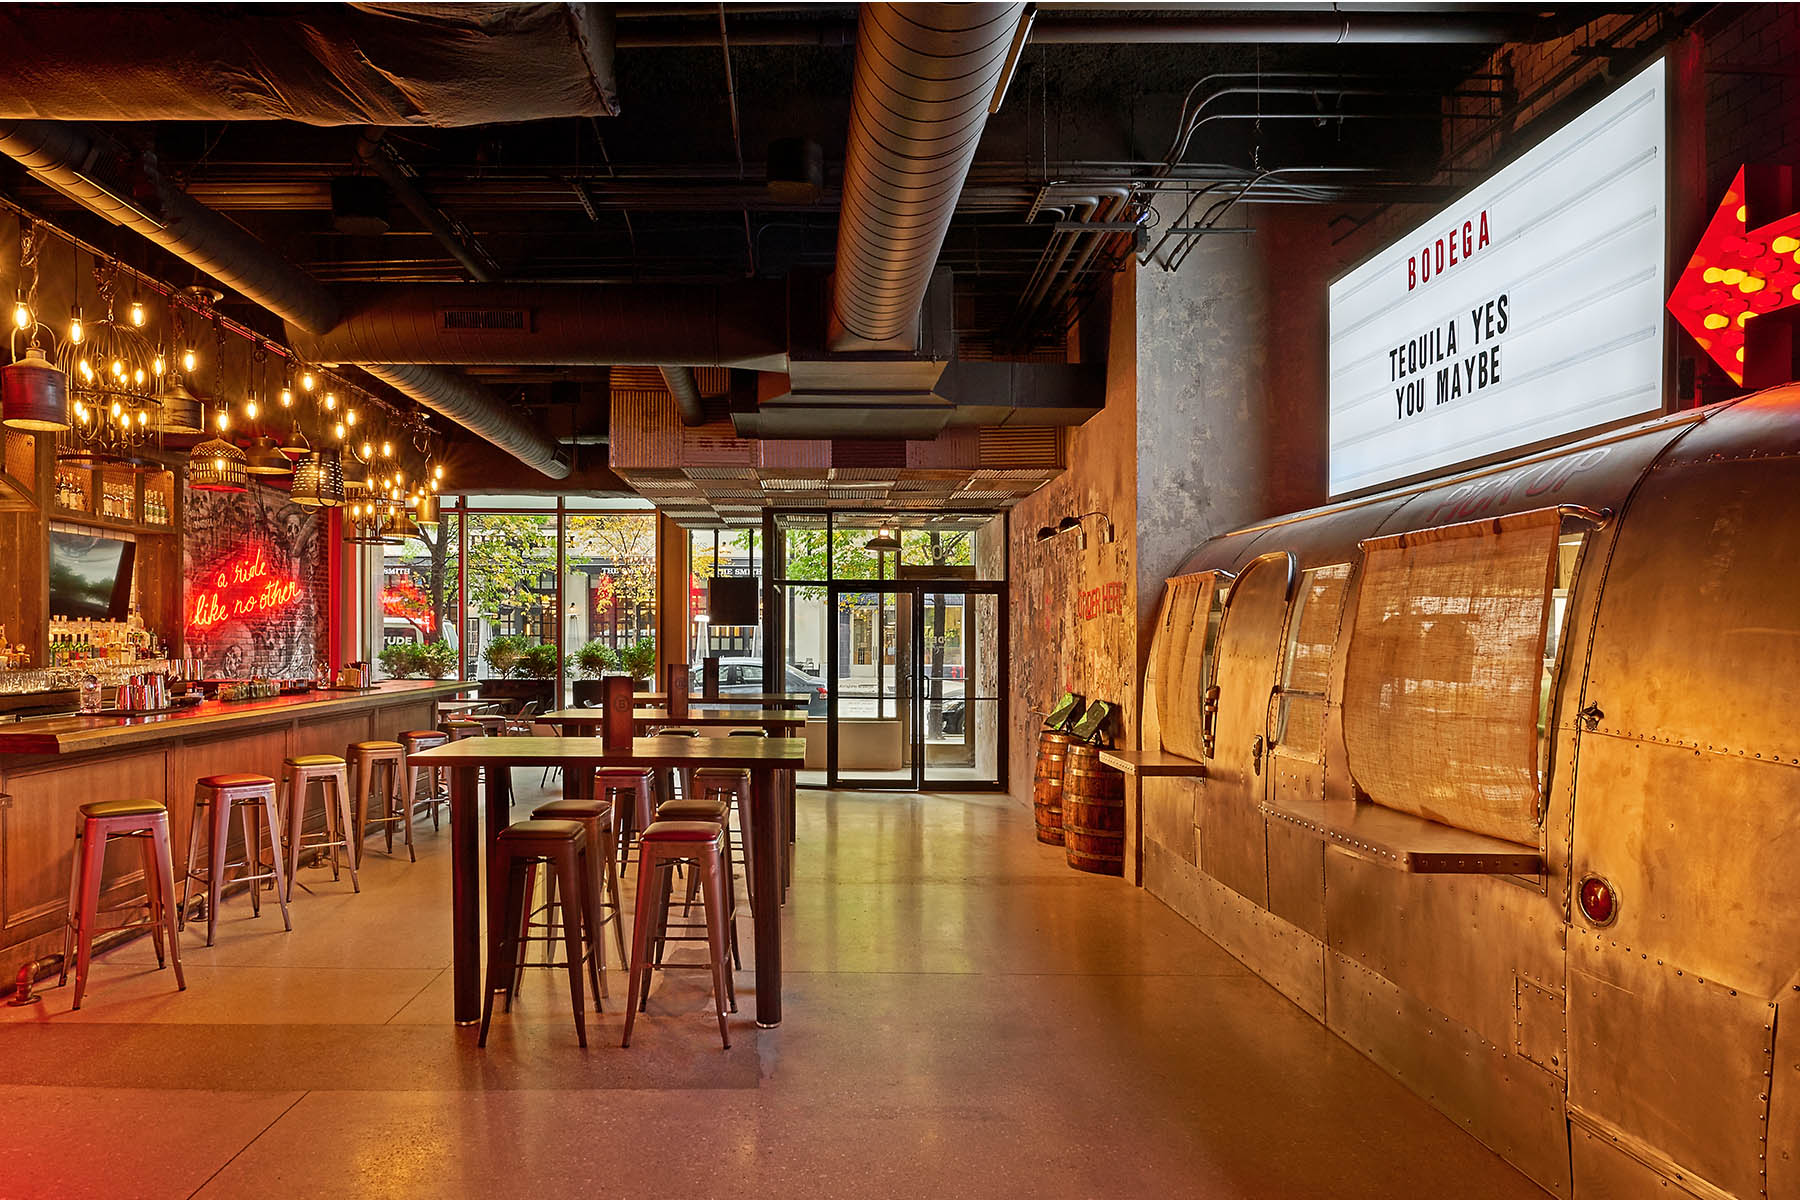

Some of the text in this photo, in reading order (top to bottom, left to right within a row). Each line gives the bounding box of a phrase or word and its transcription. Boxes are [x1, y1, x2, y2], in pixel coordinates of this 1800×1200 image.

[1408, 210, 1490, 291] BODEGA
[1389, 294, 1508, 381] TEQUILA YES
[1396, 345, 1500, 420] YOU MAYBE
[1525, 447, 1612, 497] UP
[217, 548, 267, 588] a ride
[383, 567, 411, 575] SMITH
[191, 580, 302, 626] like no other
[1102, 581, 1123, 616] HERE
